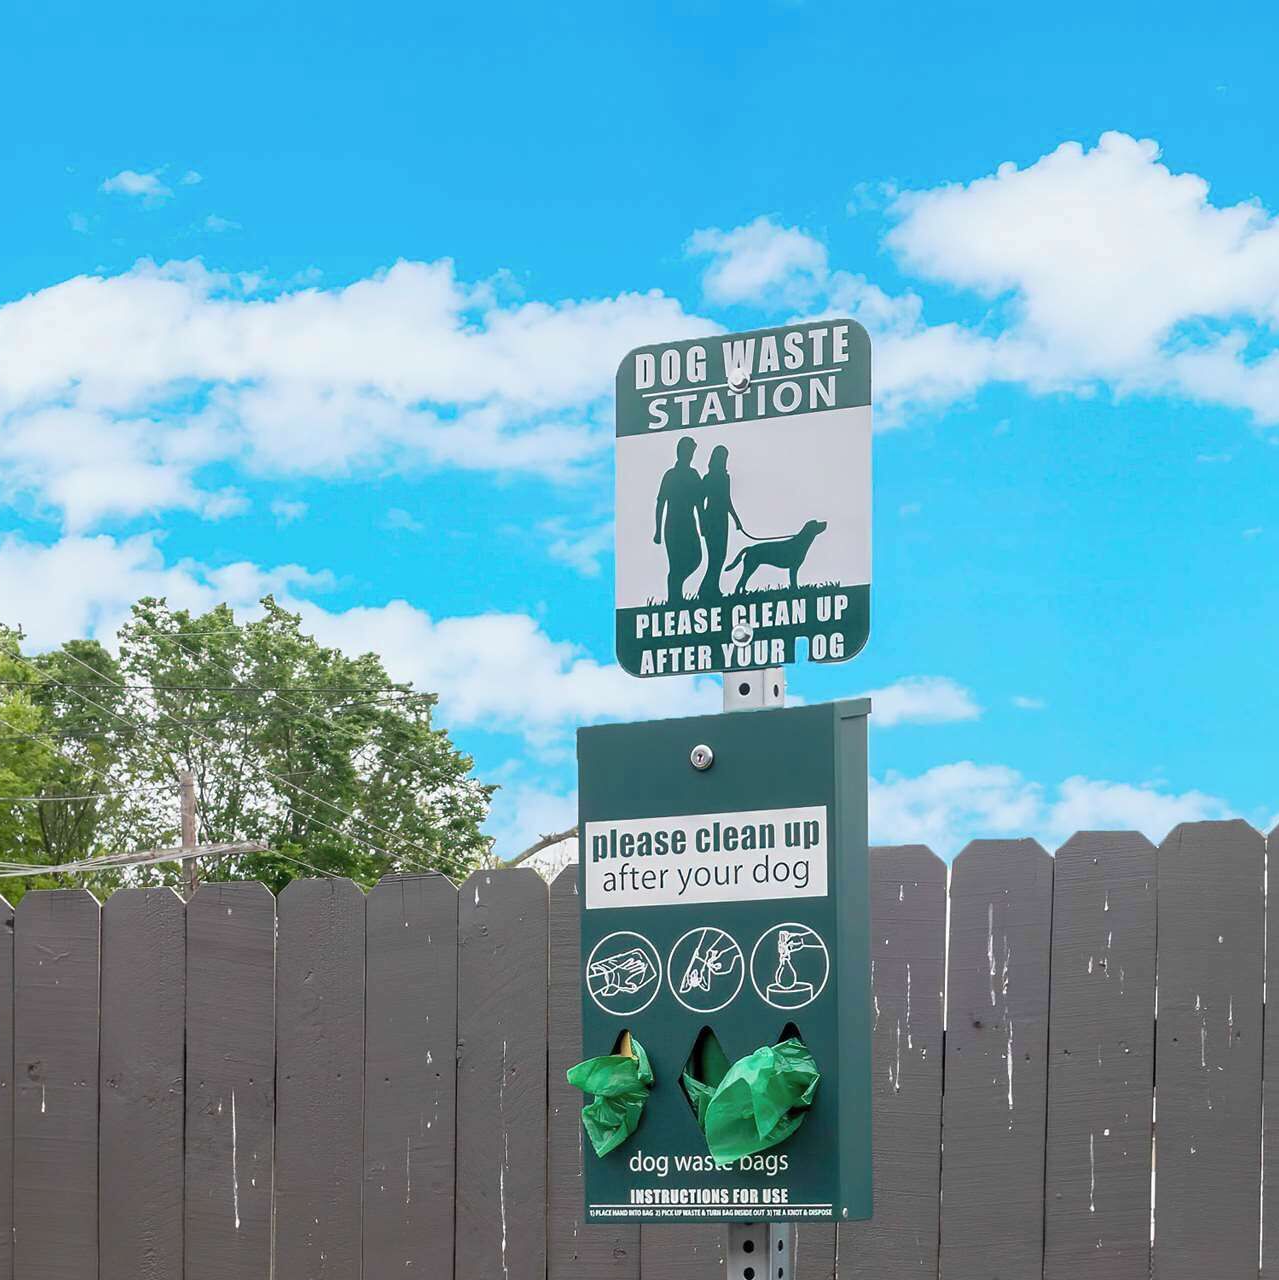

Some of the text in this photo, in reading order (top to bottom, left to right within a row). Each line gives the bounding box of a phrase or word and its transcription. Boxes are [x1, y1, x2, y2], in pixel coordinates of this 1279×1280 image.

[635, 325, 849, 390] DOG WASTE
[648, 375, 836, 430] STATION
[635, 595, 849, 639] PLEASE CLEAN UP
[639, 645, 712, 675] AFTER
[721, 638, 785, 668] YOUR
[592, 819, 820, 863] please clean up
[603, 854, 810, 896] after your dog
[629, 1150, 669, 1177] dog
[740, 1153, 789, 1177] bags
[596, 1209, 611, 1217] PLACE
[612, 1209, 628, 1217] HAND
[629, 1209, 641, 1217] INTO
[642, 1209, 653, 1217] BAG
[662, 1209, 674, 1217] PICK
[682, 1209, 700, 1217] WASTE
[706, 1209, 721, 1217] TURN
[722, 1209, 733, 1217] BAG
[734, 1209, 752, 1217] INSIDE
[753, 1208, 765, 1216] OUT
[787, 1208, 802, 1216] KNOT
[808, 1208, 832, 1216] DISPOSE
[630, 1188, 789, 1204] INSTRUCTIONS FOR USE
